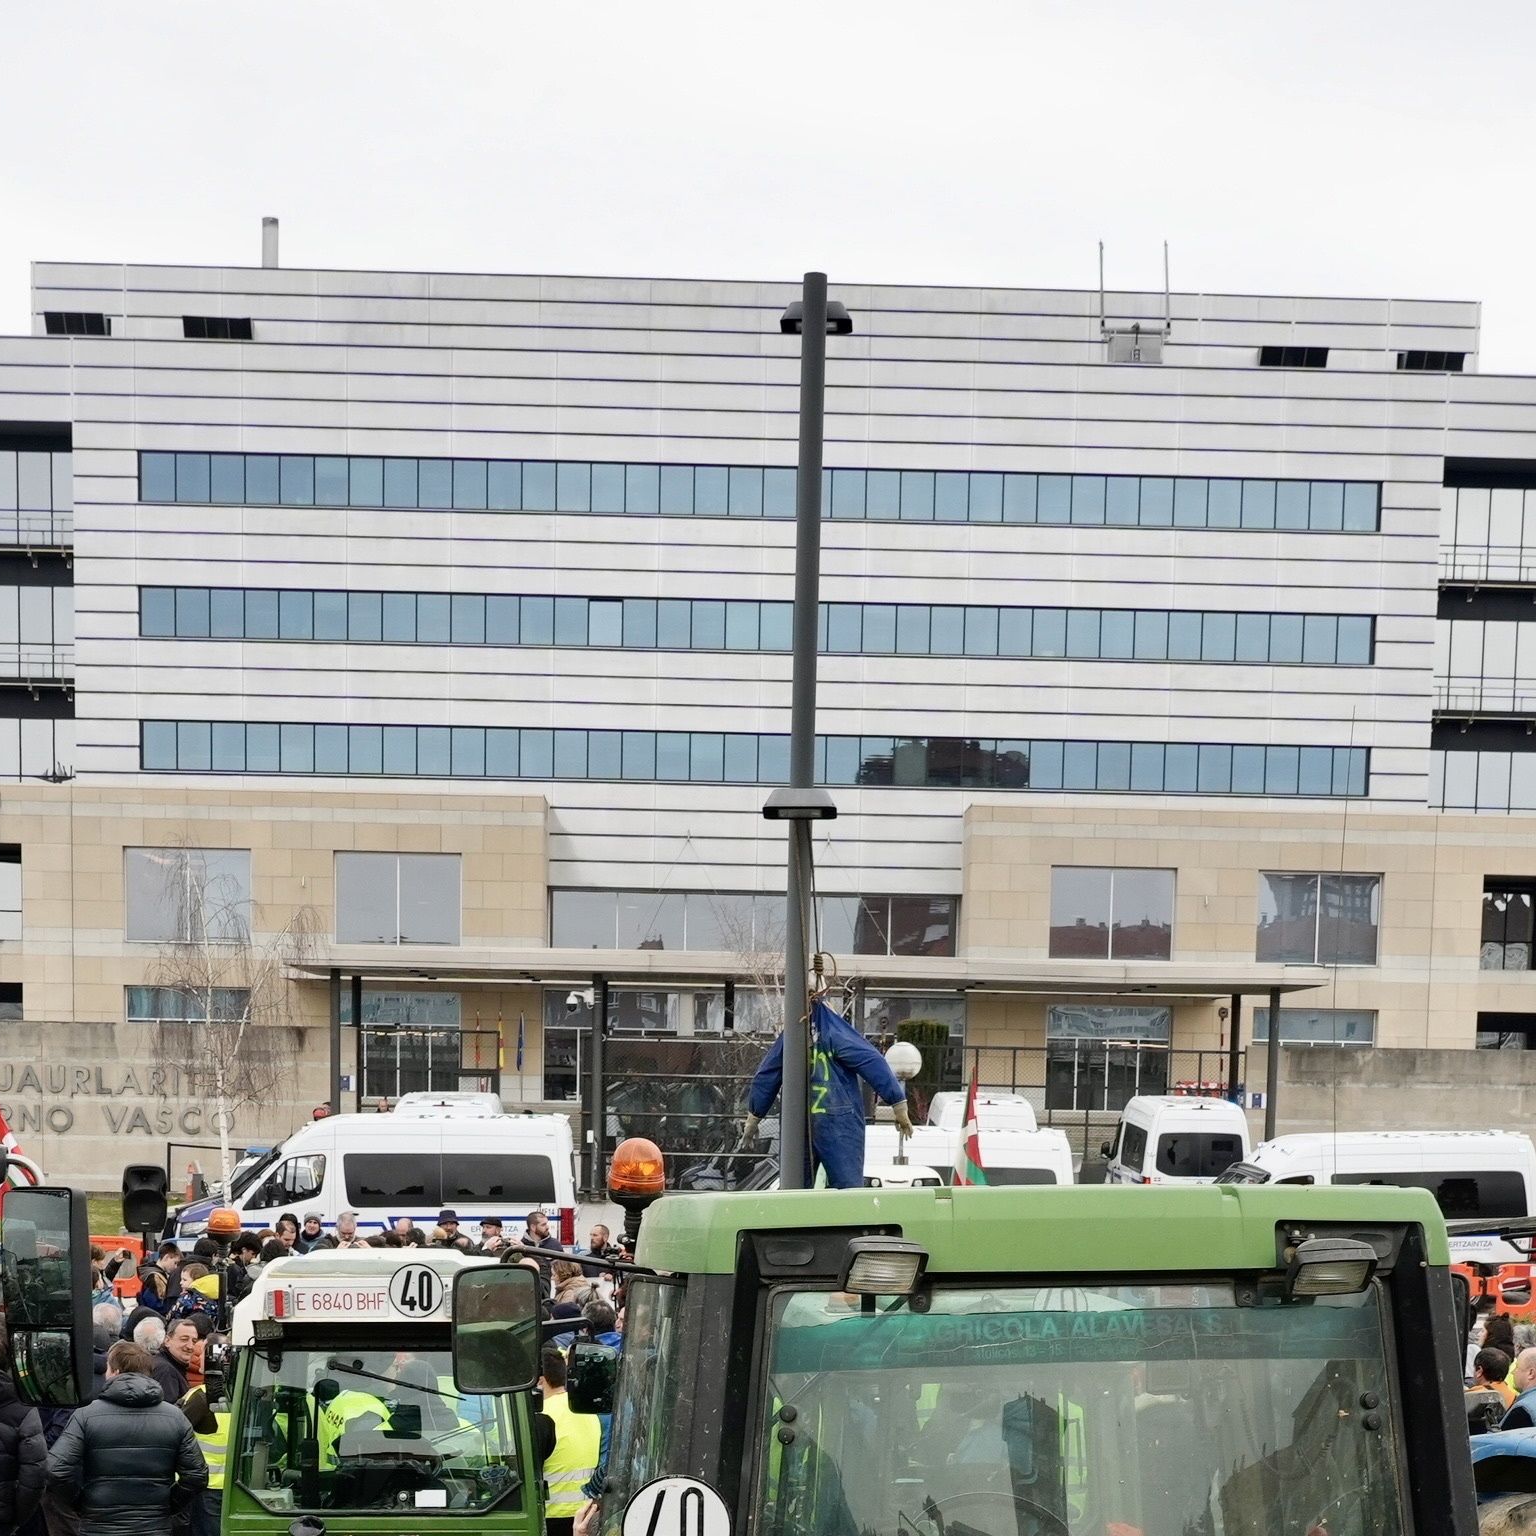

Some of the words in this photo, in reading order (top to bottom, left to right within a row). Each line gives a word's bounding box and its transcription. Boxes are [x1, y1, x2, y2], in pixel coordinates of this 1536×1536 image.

[101, 1103, 235, 1136] VASCO
[296, 1293, 306, 1311] E
[312, 1293, 353, 1311] 6840
[357, 1293, 387, 1311] BHF
[400, 1270, 433, 1312] 40
[931, 1316, 1059, 1342] GRICOLA
